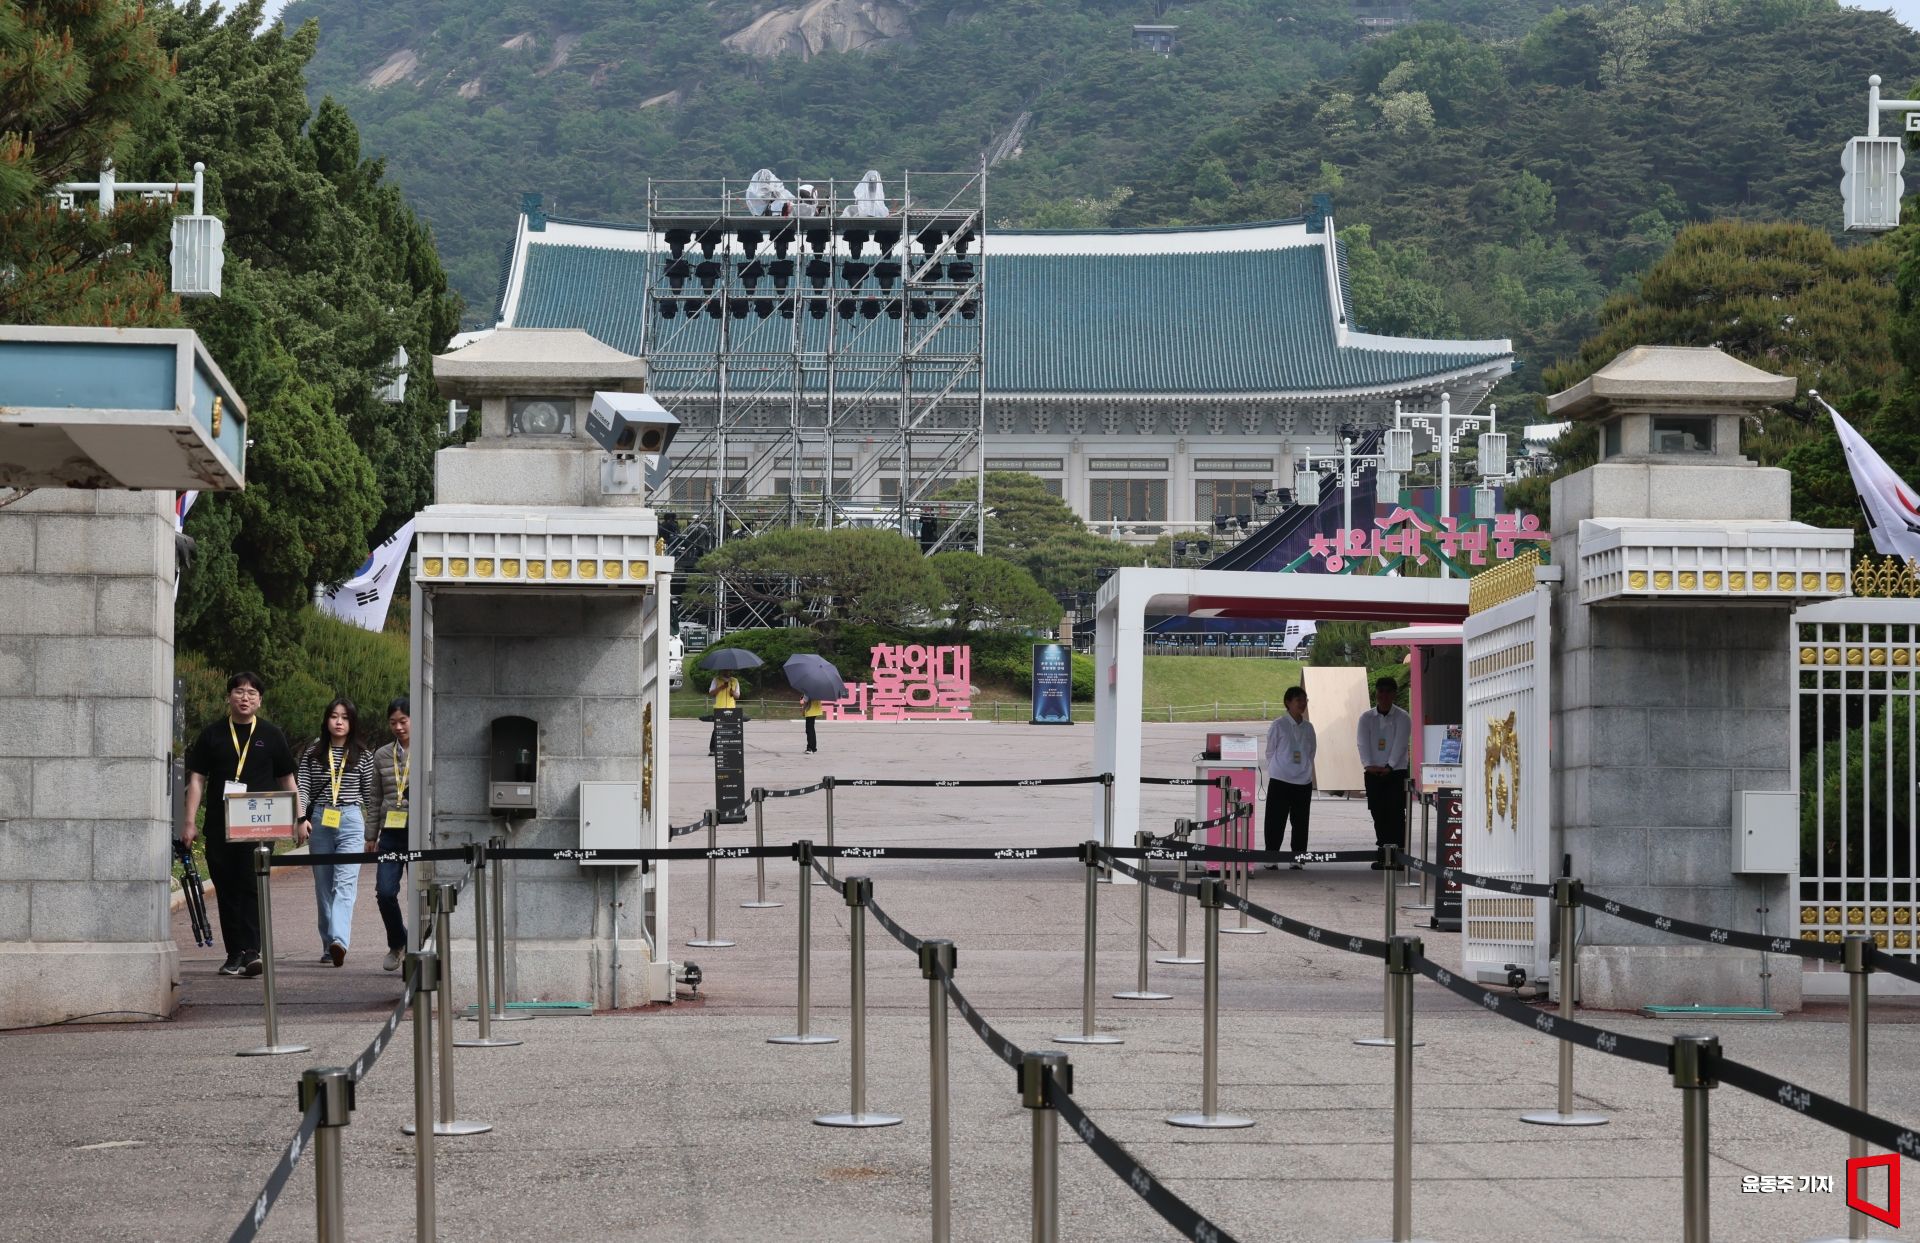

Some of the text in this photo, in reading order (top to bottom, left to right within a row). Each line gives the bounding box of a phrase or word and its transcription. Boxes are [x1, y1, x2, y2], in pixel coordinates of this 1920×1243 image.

[1436, 516, 1488, 566] 국민
[1491, 513, 1552, 559] 품으
[870, 642, 971, 684] 청와대
[872, 682, 973, 721] 품으로
[251, 814, 272, 823] EXIT
